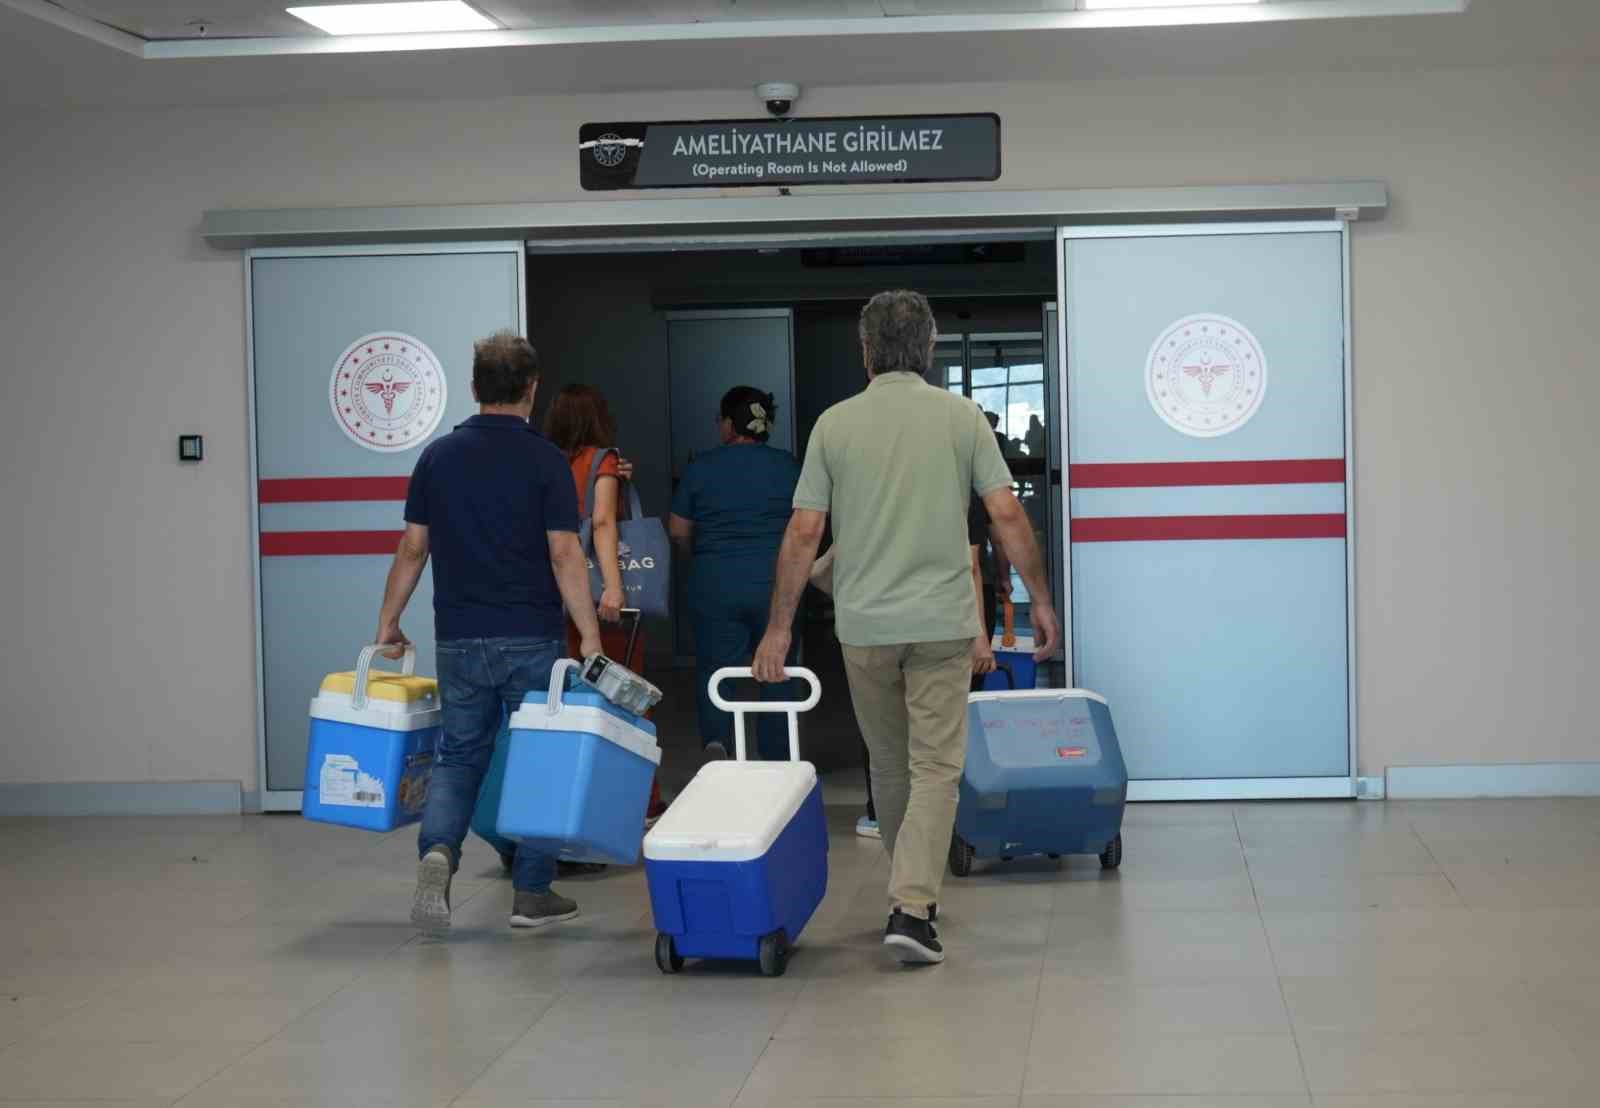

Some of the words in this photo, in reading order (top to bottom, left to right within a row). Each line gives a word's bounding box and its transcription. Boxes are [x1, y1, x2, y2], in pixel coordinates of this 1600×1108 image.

[672, 127, 836, 156] AMELİYATHANE
[842, 125, 943, 152] GİRİLMEZ
[692, 163, 764, 179] (Operating
[767, 162, 805, 175] Room
[807, 161, 819, 174] Is
[822, 161, 847, 173] Not
[850, 159, 908, 173] Allowed)
